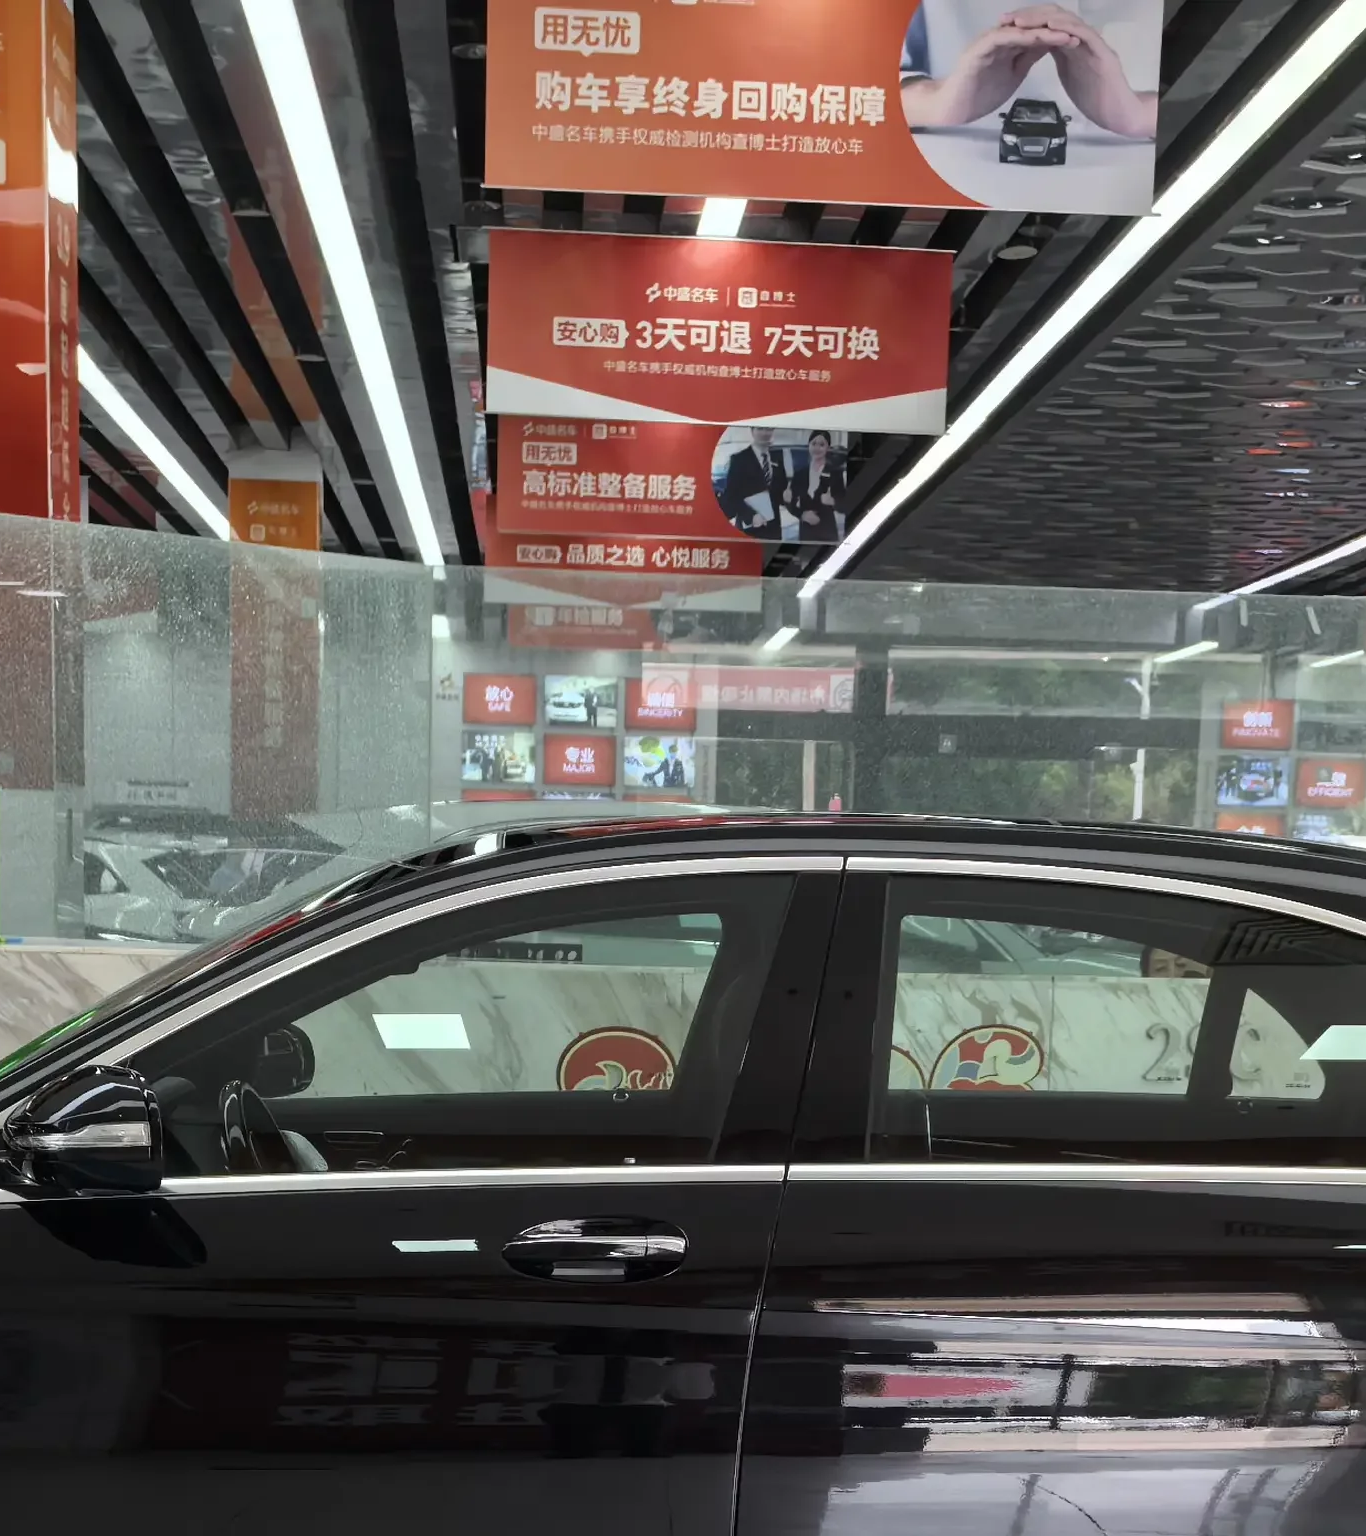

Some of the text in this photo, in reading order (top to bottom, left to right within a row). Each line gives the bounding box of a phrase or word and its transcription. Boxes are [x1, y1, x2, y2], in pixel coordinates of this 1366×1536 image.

[540, 14, 632, 48] 用无忧
[534, 71, 887, 127] 购车享终身回购保障
[663, 285, 719, 303] 中盛名车
[556, 317, 880, 361] 安心购 3天可退 7天可换
[523, 470, 697, 501] 高标准整备服务
[566, 544, 645, 567] 品质之选
[651, 546, 731, 569] 心悦服务
